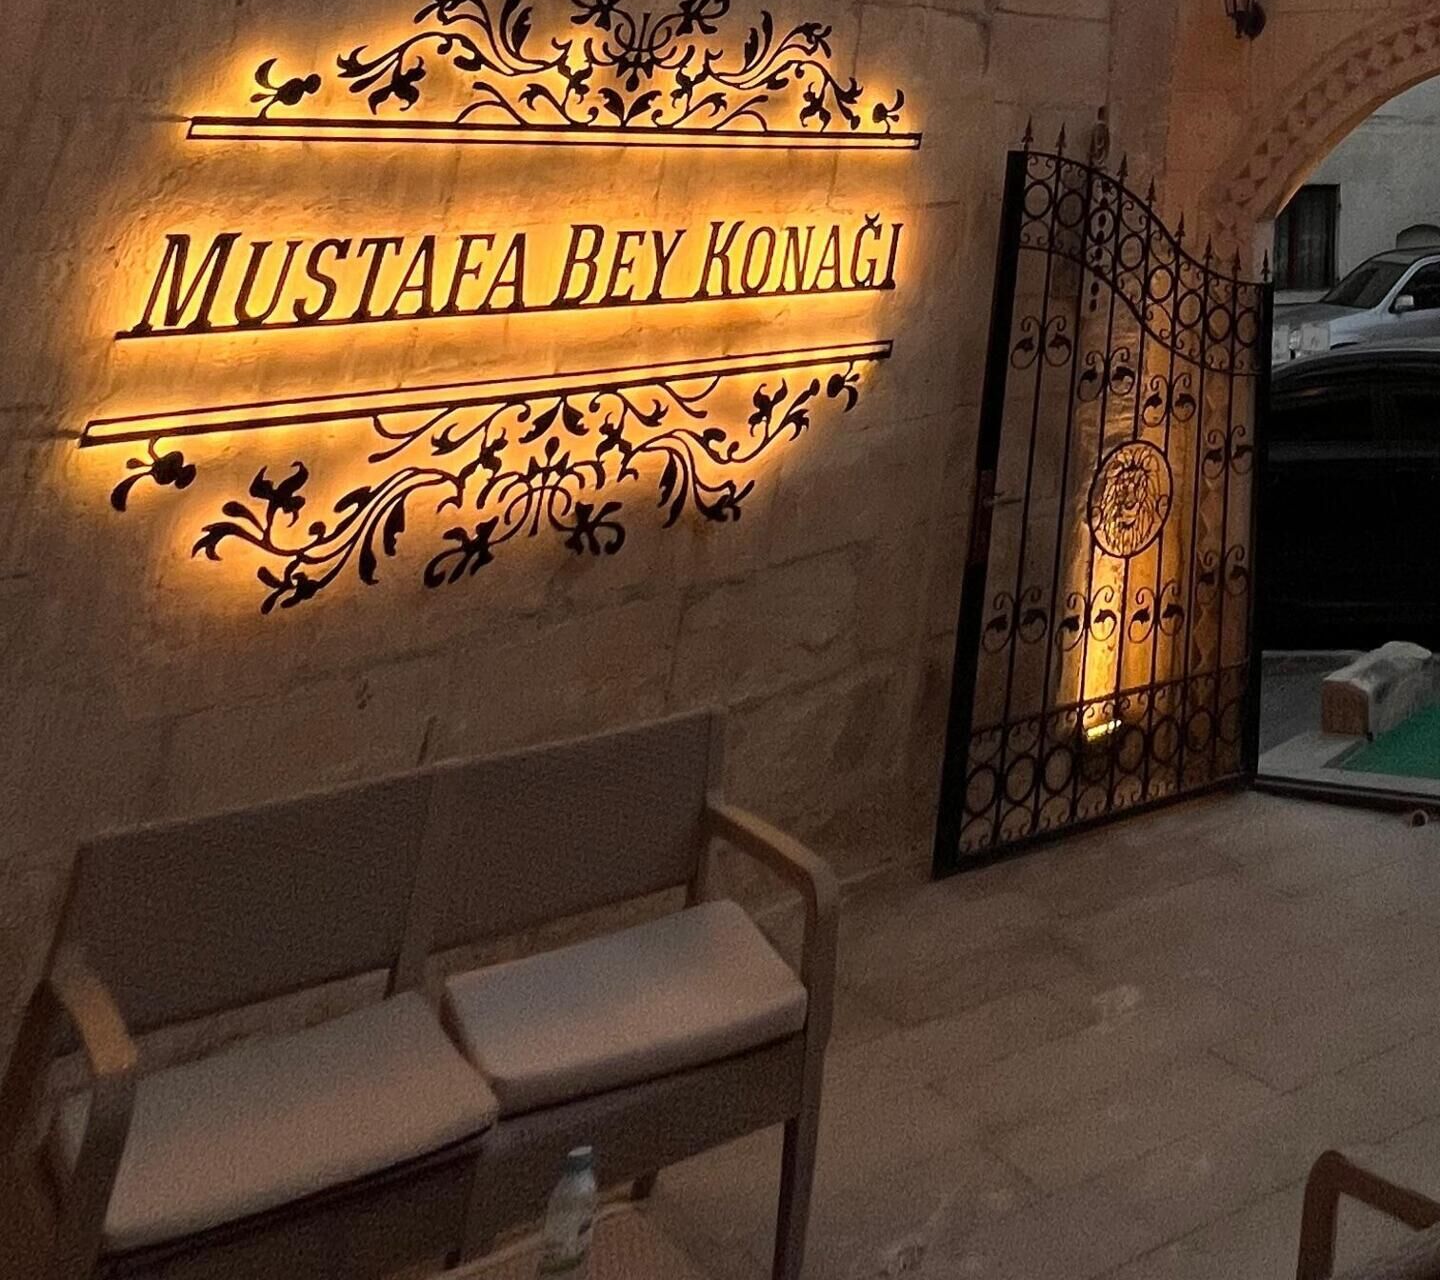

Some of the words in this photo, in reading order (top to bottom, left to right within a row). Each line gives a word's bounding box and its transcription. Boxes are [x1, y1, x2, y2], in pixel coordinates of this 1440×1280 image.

[134, 230, 528, 333] MUSTAFA
[554, 223, 687, 304] BEY
[701, 214, 905, 298] KONAĞI
